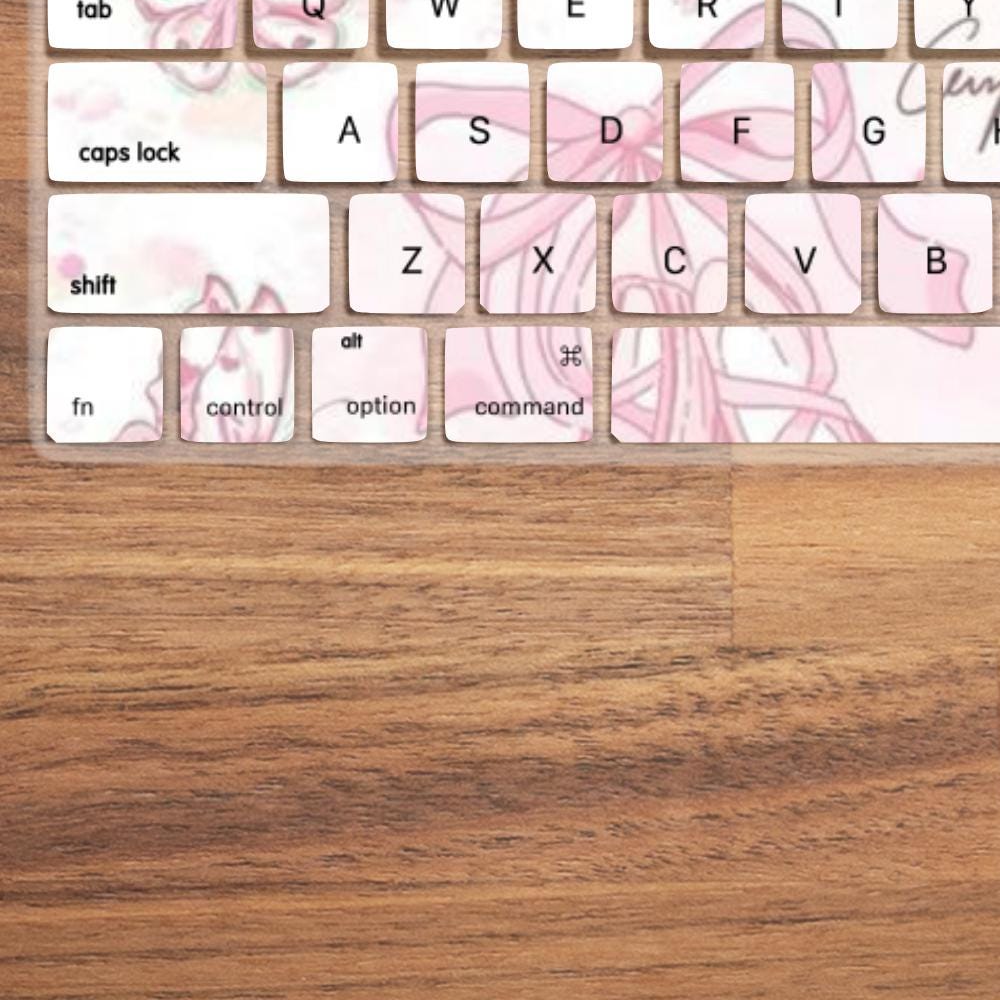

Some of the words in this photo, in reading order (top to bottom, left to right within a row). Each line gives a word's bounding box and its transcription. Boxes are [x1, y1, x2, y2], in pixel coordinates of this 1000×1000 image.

[338, 115, 361, 143] A
[469, 115, 490, 145] S
[601, 116, 623, 144] D
[733, 117, 751, 145] F
[863, 116, 885, 145] G
[79, 147, 130, 167] caps
[137, 141, 180, 162] lock
[402, 246, 422, 274] Z
[533, 246, 554, 274] X
[664, 246, 686, 275] C
[794, 247, 817, 274] V
[927, 246, 947, 275] B
[70, 274, 116, 295] shift
[341, 333, 363, 348] alt
[72, 399, 94, 415] fn
[206, 398, 283, 416] control
[347, 397, 417, 419] option
[475, 397, 584, 416] command
